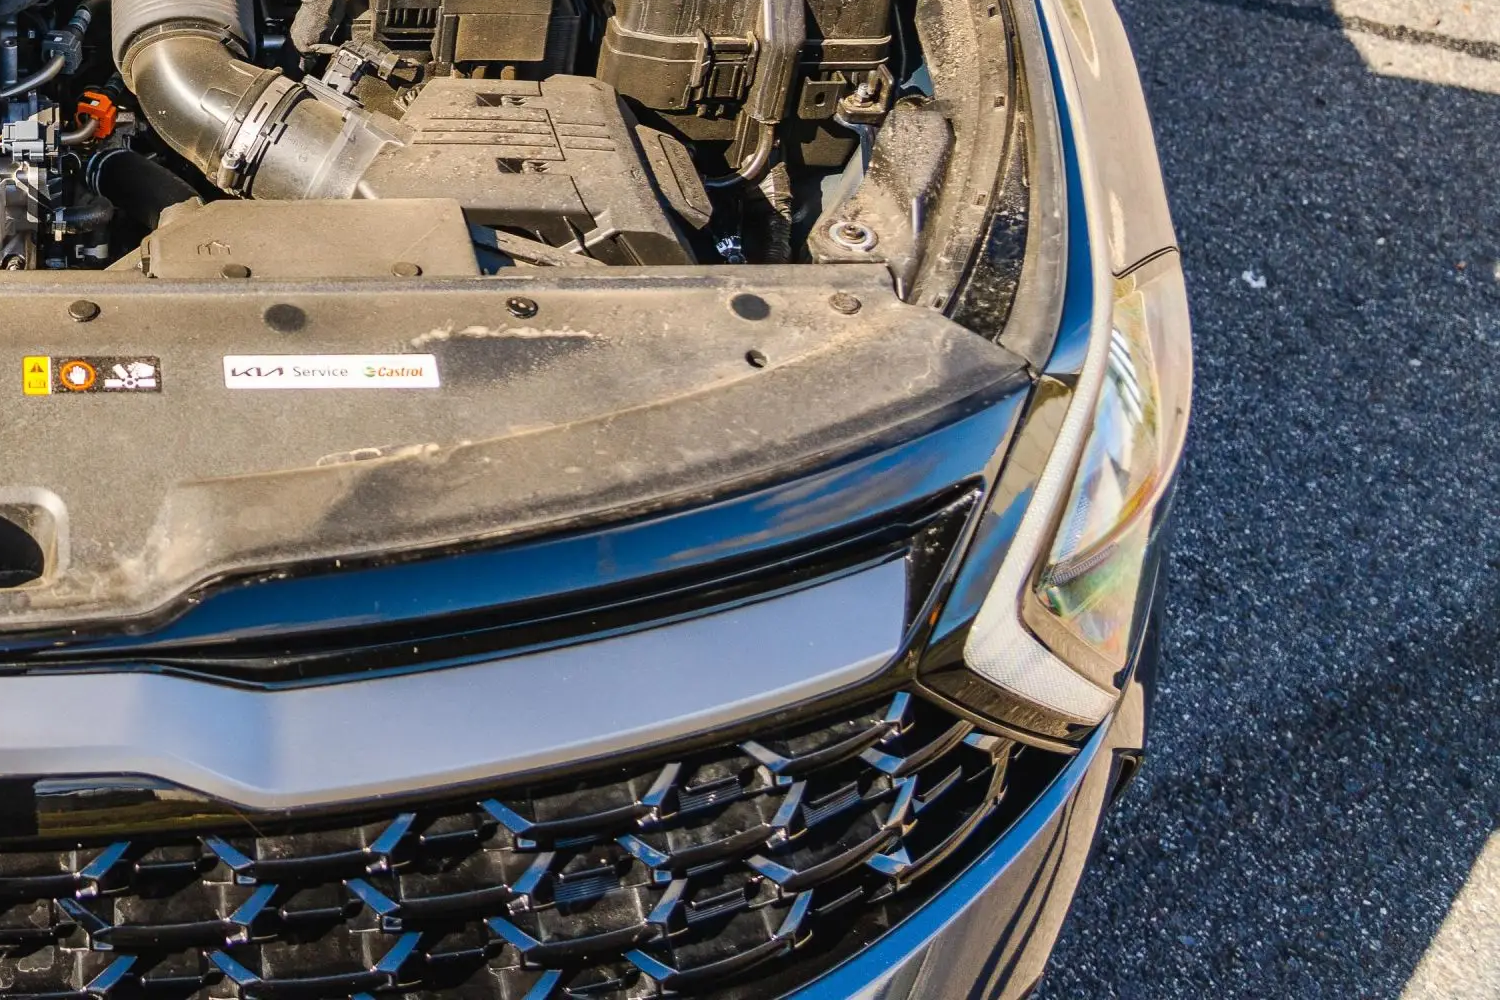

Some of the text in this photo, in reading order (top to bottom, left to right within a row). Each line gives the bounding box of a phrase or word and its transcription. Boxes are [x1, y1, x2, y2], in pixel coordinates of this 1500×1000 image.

[231, 366, 424, 378] KIA Service Castrol
